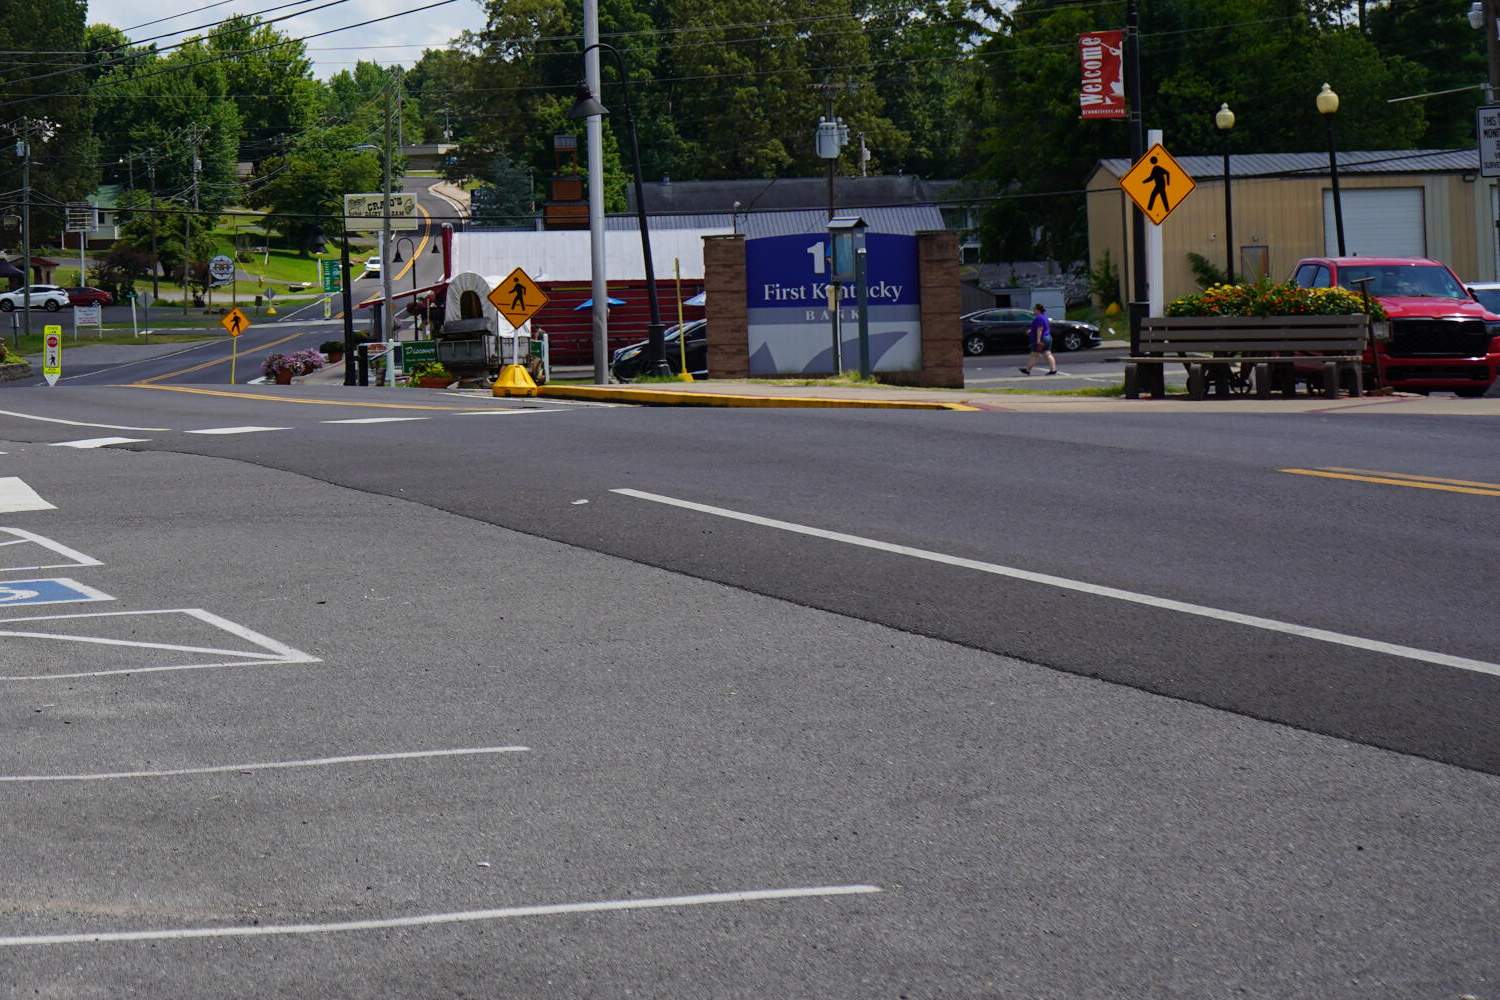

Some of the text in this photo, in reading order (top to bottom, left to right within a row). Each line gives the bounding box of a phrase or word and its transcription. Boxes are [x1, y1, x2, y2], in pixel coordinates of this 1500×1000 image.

[1080, 37, 1103, 106] Welcome
[764, 281, 902, 302] First Kntcky
